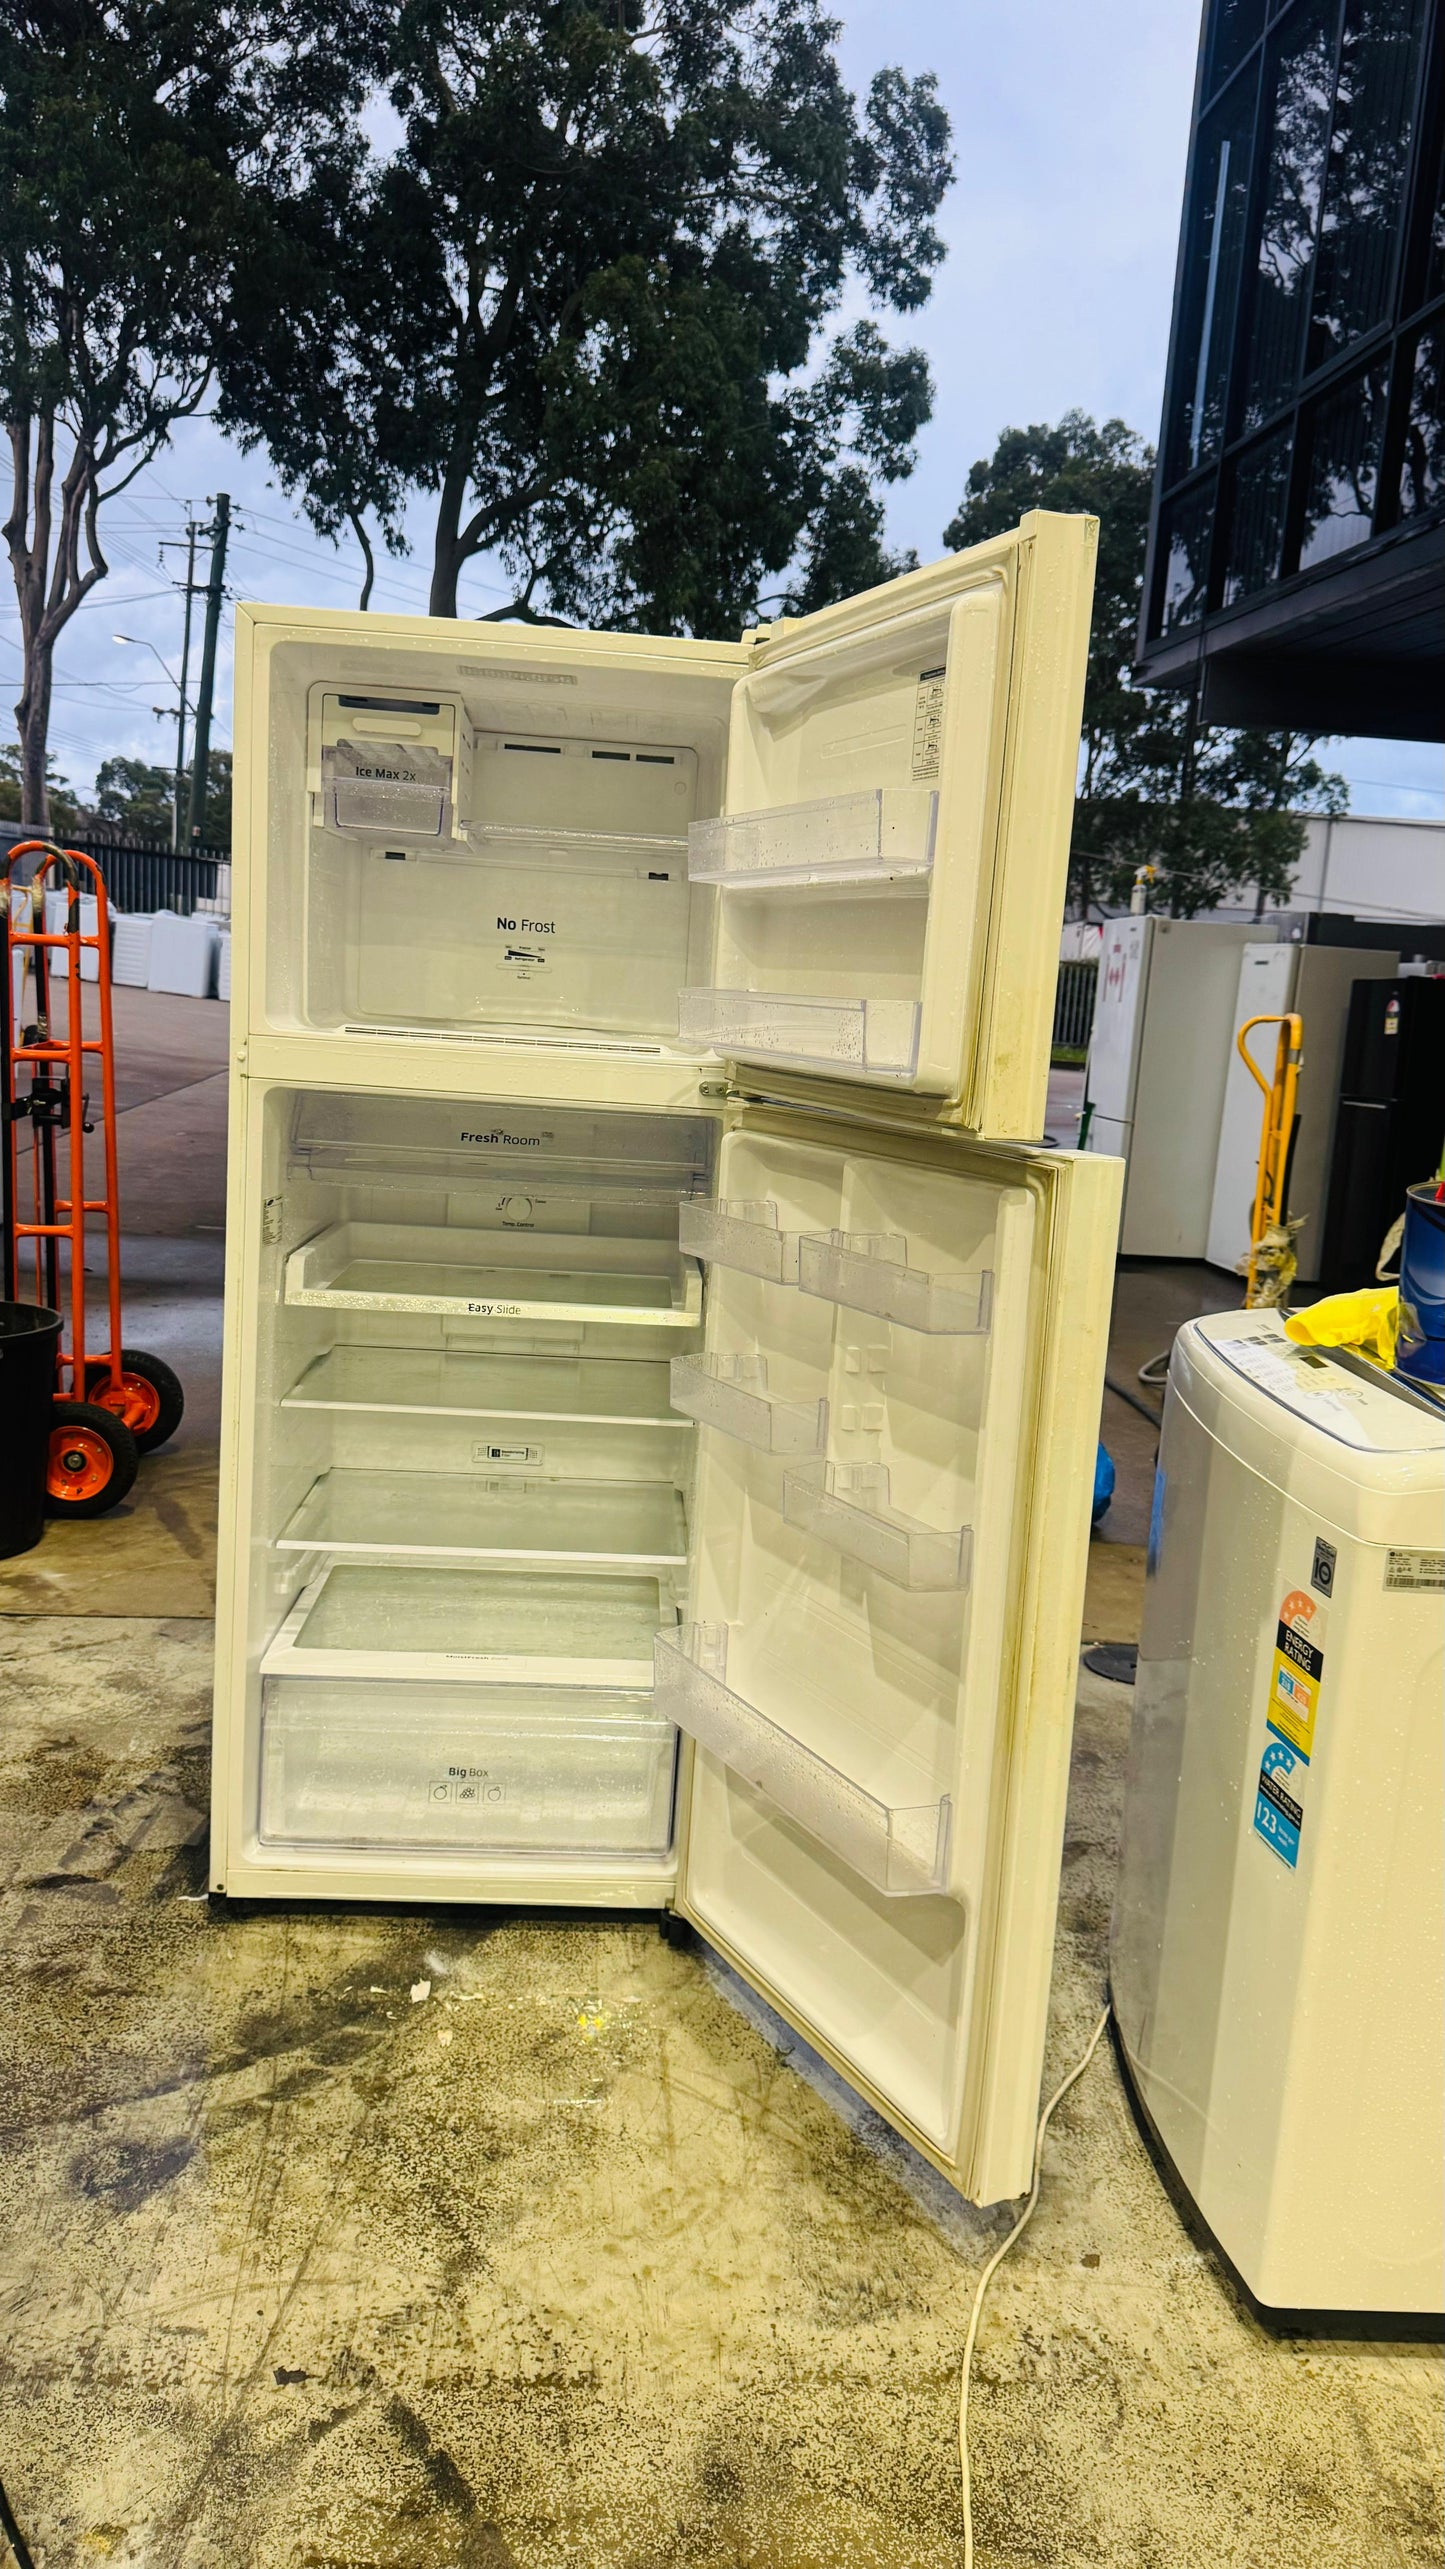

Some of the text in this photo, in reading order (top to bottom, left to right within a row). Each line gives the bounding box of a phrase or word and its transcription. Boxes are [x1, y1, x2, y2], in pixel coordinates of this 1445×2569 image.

[355, 766, 416, 781] Ice Max 2x
[497, 917, 556, 934] No Frost
[460, 1132, 499, 1143] Fresh
[503, 1134, 540, 1146] Room
[468, 1303, 521, 1315] Easy Slide
[1314, 1557, 1332, 1585] 10
[1285, 1629, 1314, 1659] ENERGY
[1284, 1641, 1312, 1671] RATING
[448, 1766, 489, 1779] Big Box
[1261, 1775, 1280, 1798] WATER
[1280, 1792, 1302, 1819] RATING
[1256, 1800, 1277, 1834] 123
